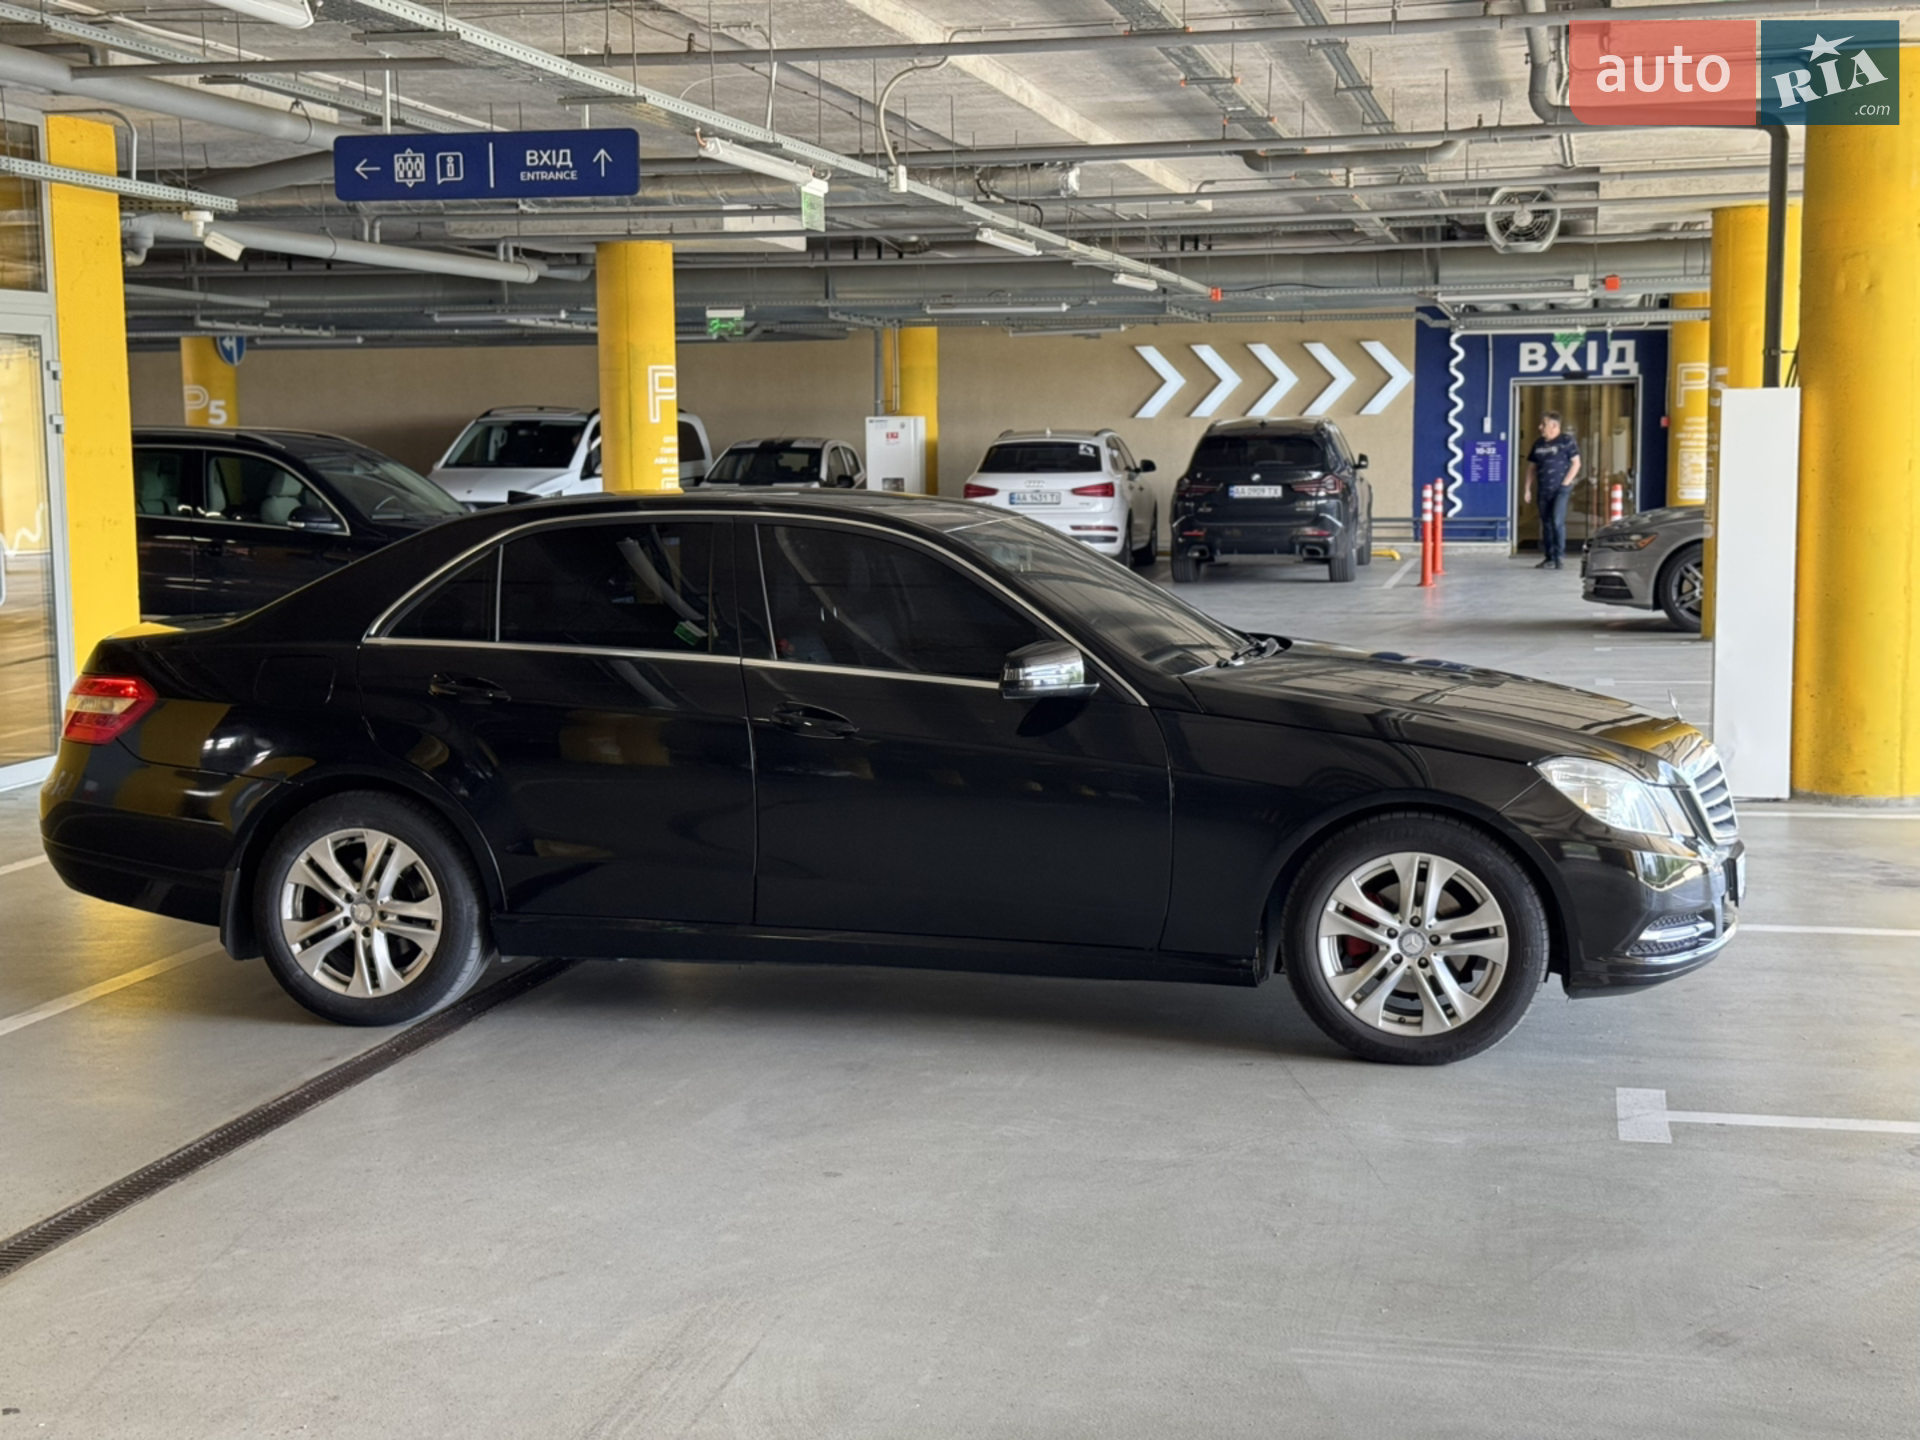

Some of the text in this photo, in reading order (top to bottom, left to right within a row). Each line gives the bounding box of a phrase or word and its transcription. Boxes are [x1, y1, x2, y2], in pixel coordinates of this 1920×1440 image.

[525, 148, 573, 169] ВХІД
[519, 170, 578, 181] ENTRANCE
[1518, 339, 1640, 376] ВХІД
